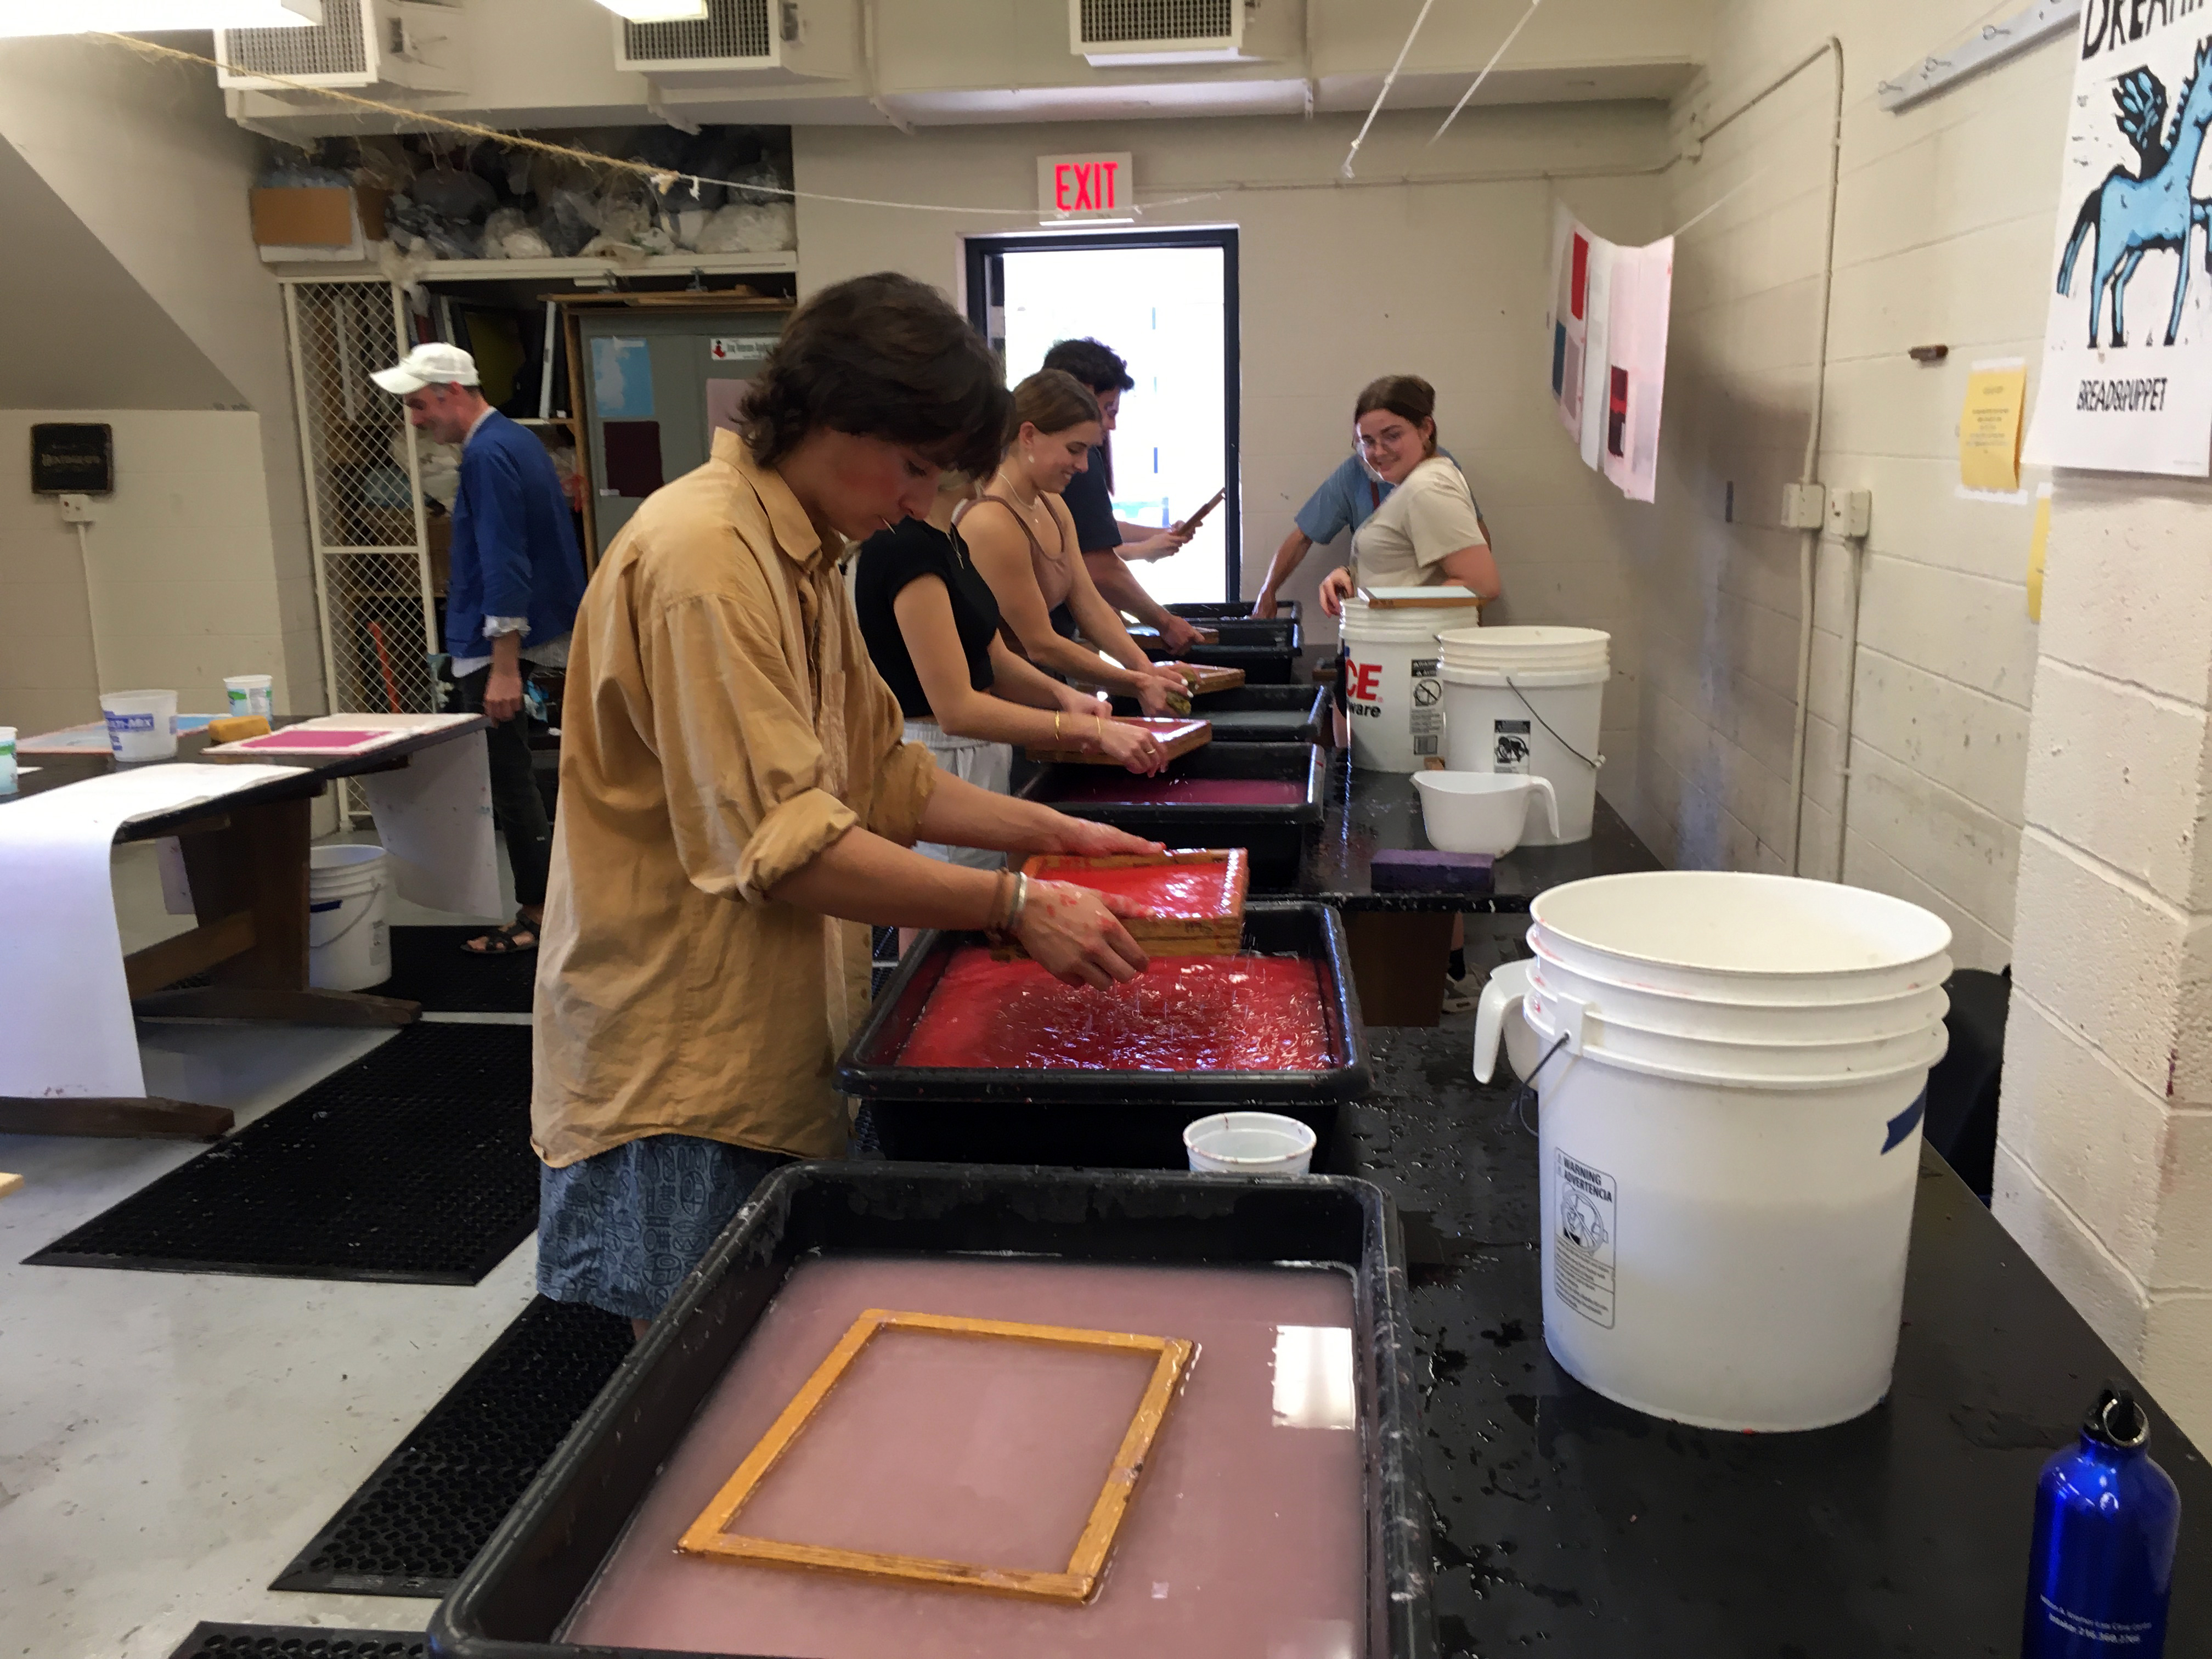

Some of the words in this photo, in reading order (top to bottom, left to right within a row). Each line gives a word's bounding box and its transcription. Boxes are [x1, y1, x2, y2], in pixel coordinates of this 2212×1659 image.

[1054, 161, 1119, 212] EXIT
[1563, 1156, 1602, 1187] WARNING
[1564, 1170, 1613, 1203] ADVERTENCIA
